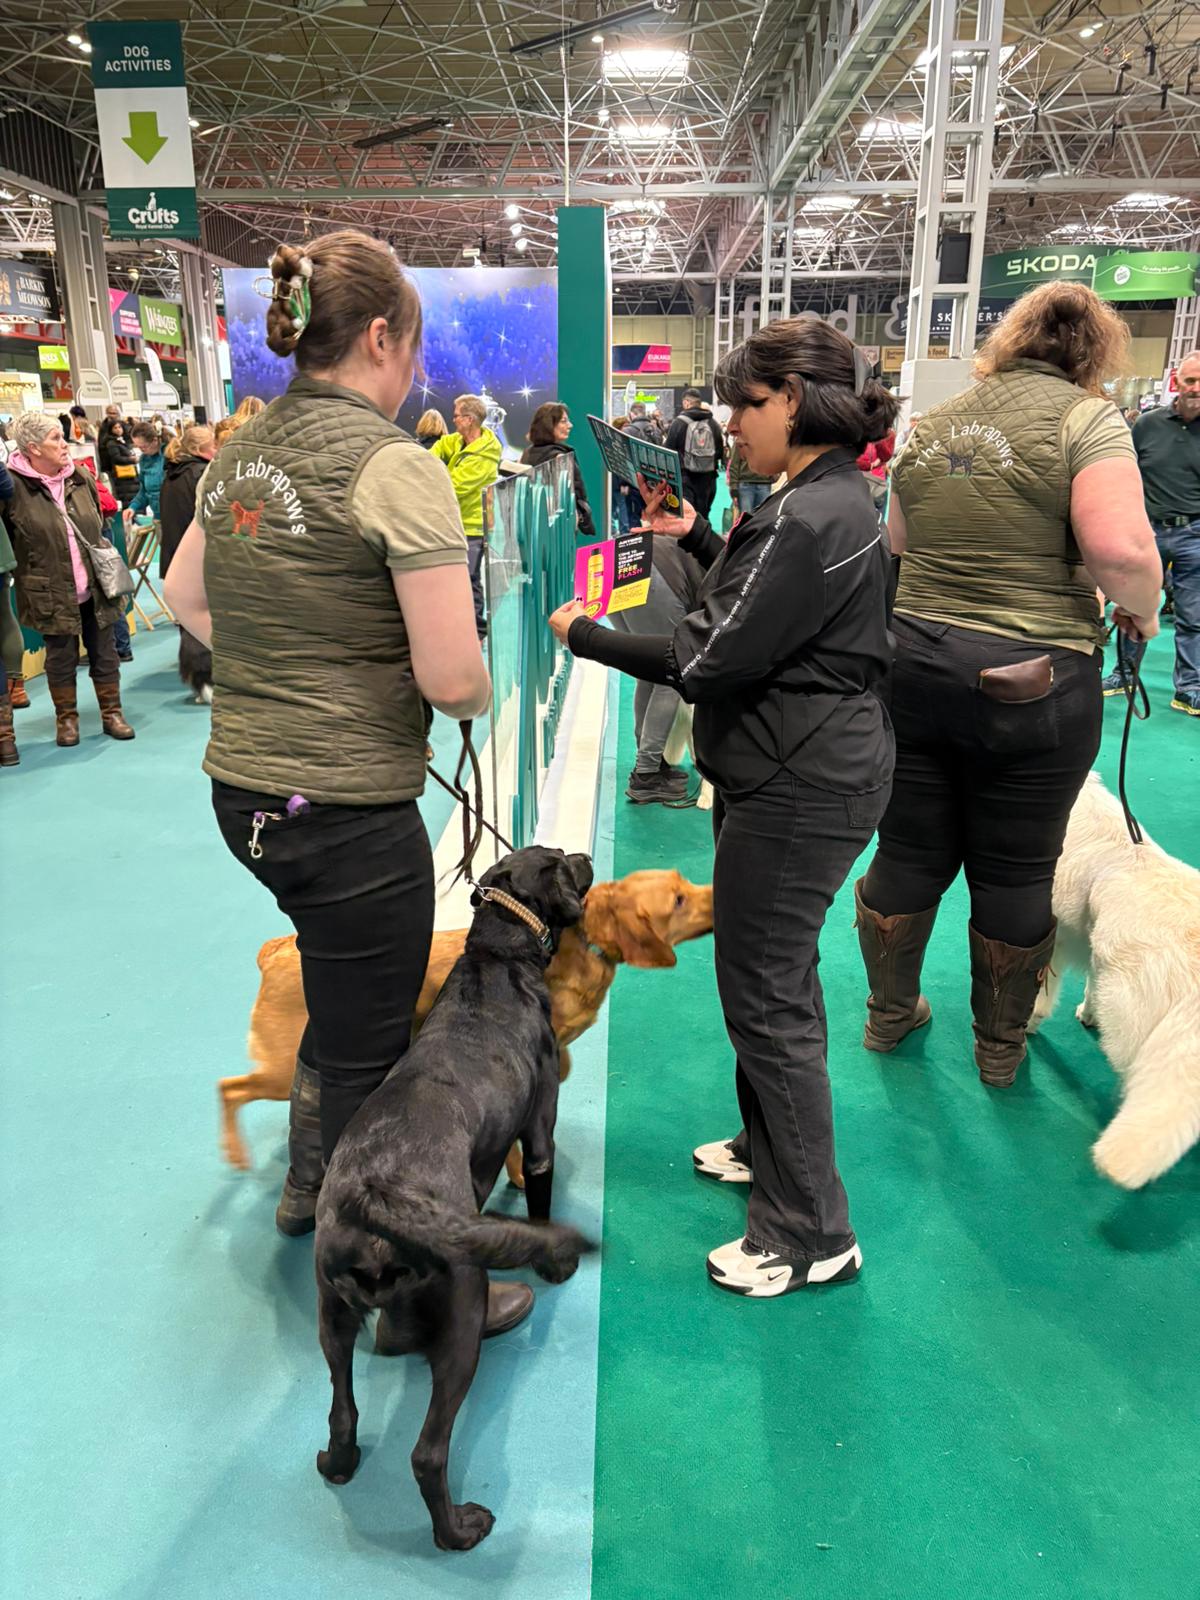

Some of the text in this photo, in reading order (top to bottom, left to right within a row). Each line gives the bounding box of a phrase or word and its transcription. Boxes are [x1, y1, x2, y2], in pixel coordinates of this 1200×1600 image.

[123, 45, 150, 57] DOG
[105, 59, 172, 72] ACTIVITIES
[128, 207, 179, 224] Crufts
[937, 312, 1003, 322] SKER'S
[914, 420, 1014, 468] The Labrapaws
[204, 455, 306, 535] The Labrapaws
[758, 535, 776, 564] ARTERO
[617, 567, 643, 580] FLASH
[618, 564, 638, 574] FREE
[741, 568, 758, 596] ARTERO
[722, 600, 741, 626] ARTERO
